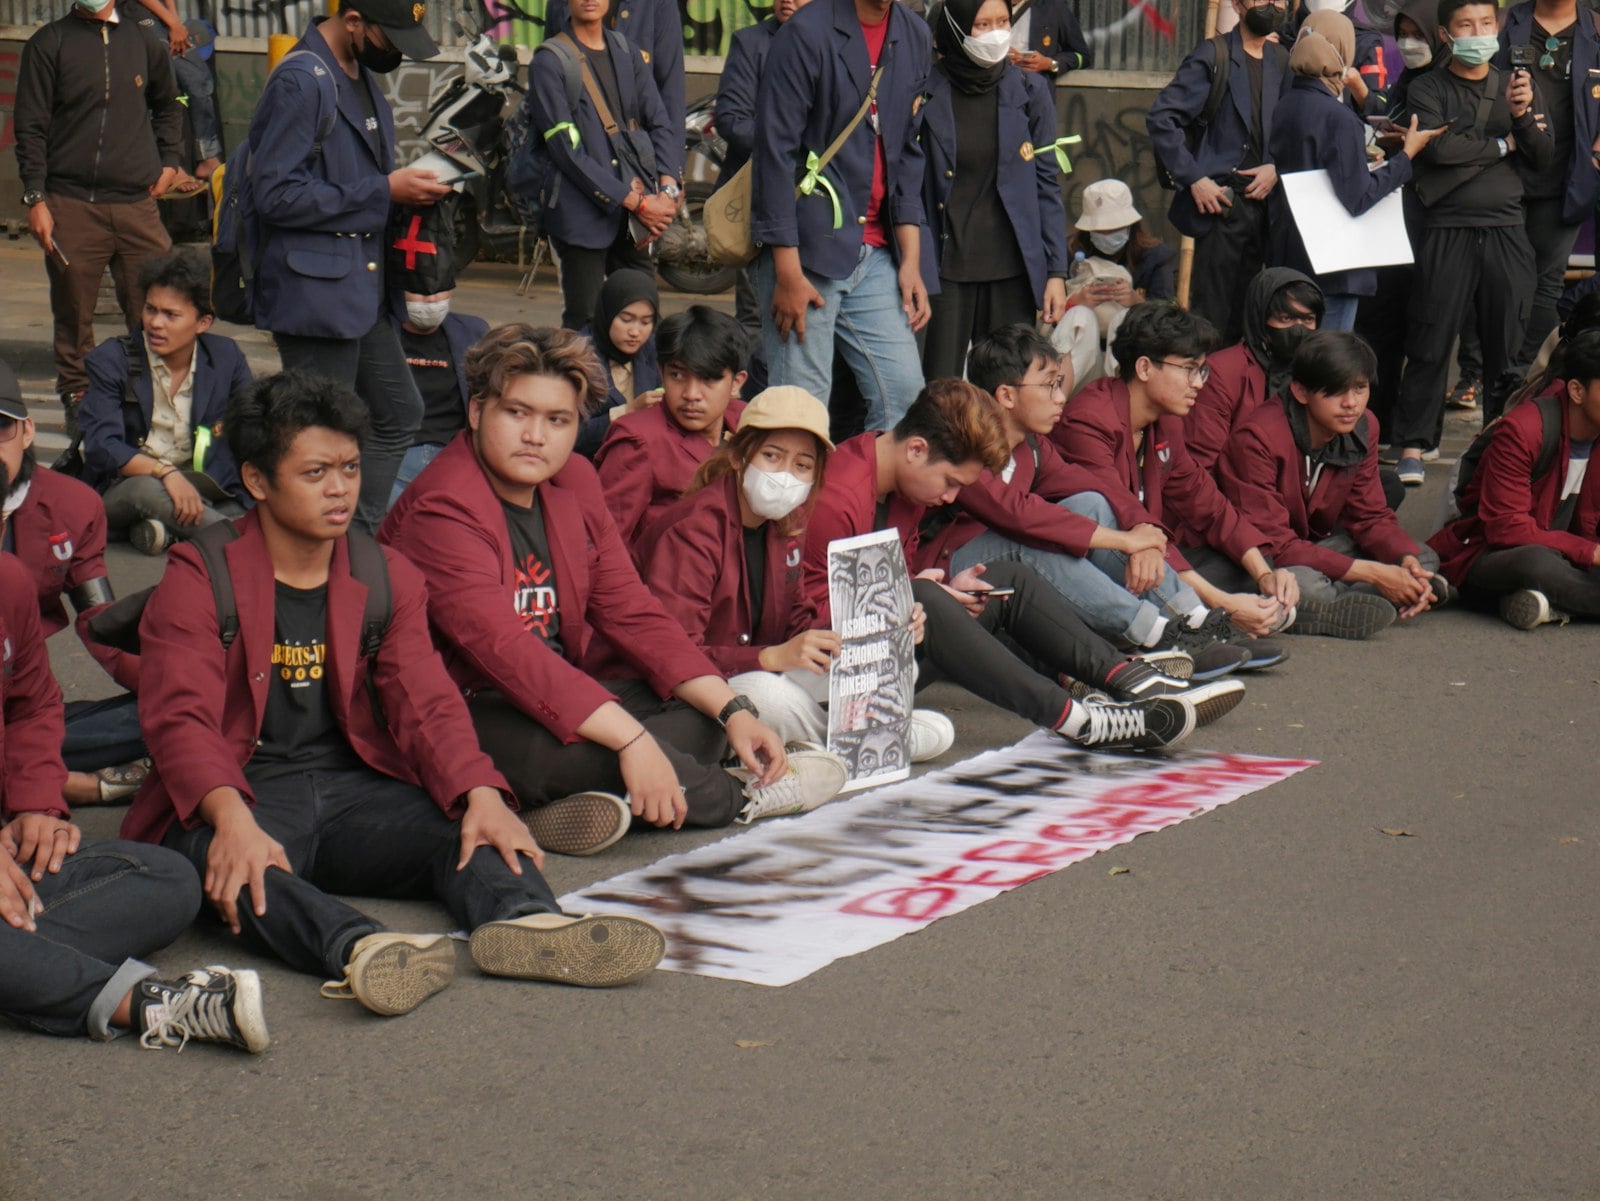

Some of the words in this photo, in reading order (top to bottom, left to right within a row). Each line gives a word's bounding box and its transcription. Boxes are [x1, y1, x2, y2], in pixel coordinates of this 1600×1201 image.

[841, 613, 879, 640] ASPIRASI
[840, 639, 890, 669] DEMOKRASI
[839, 671, 878, 697] DIKEBIRI
[840, 754, 1319, 921] BERGERAK
